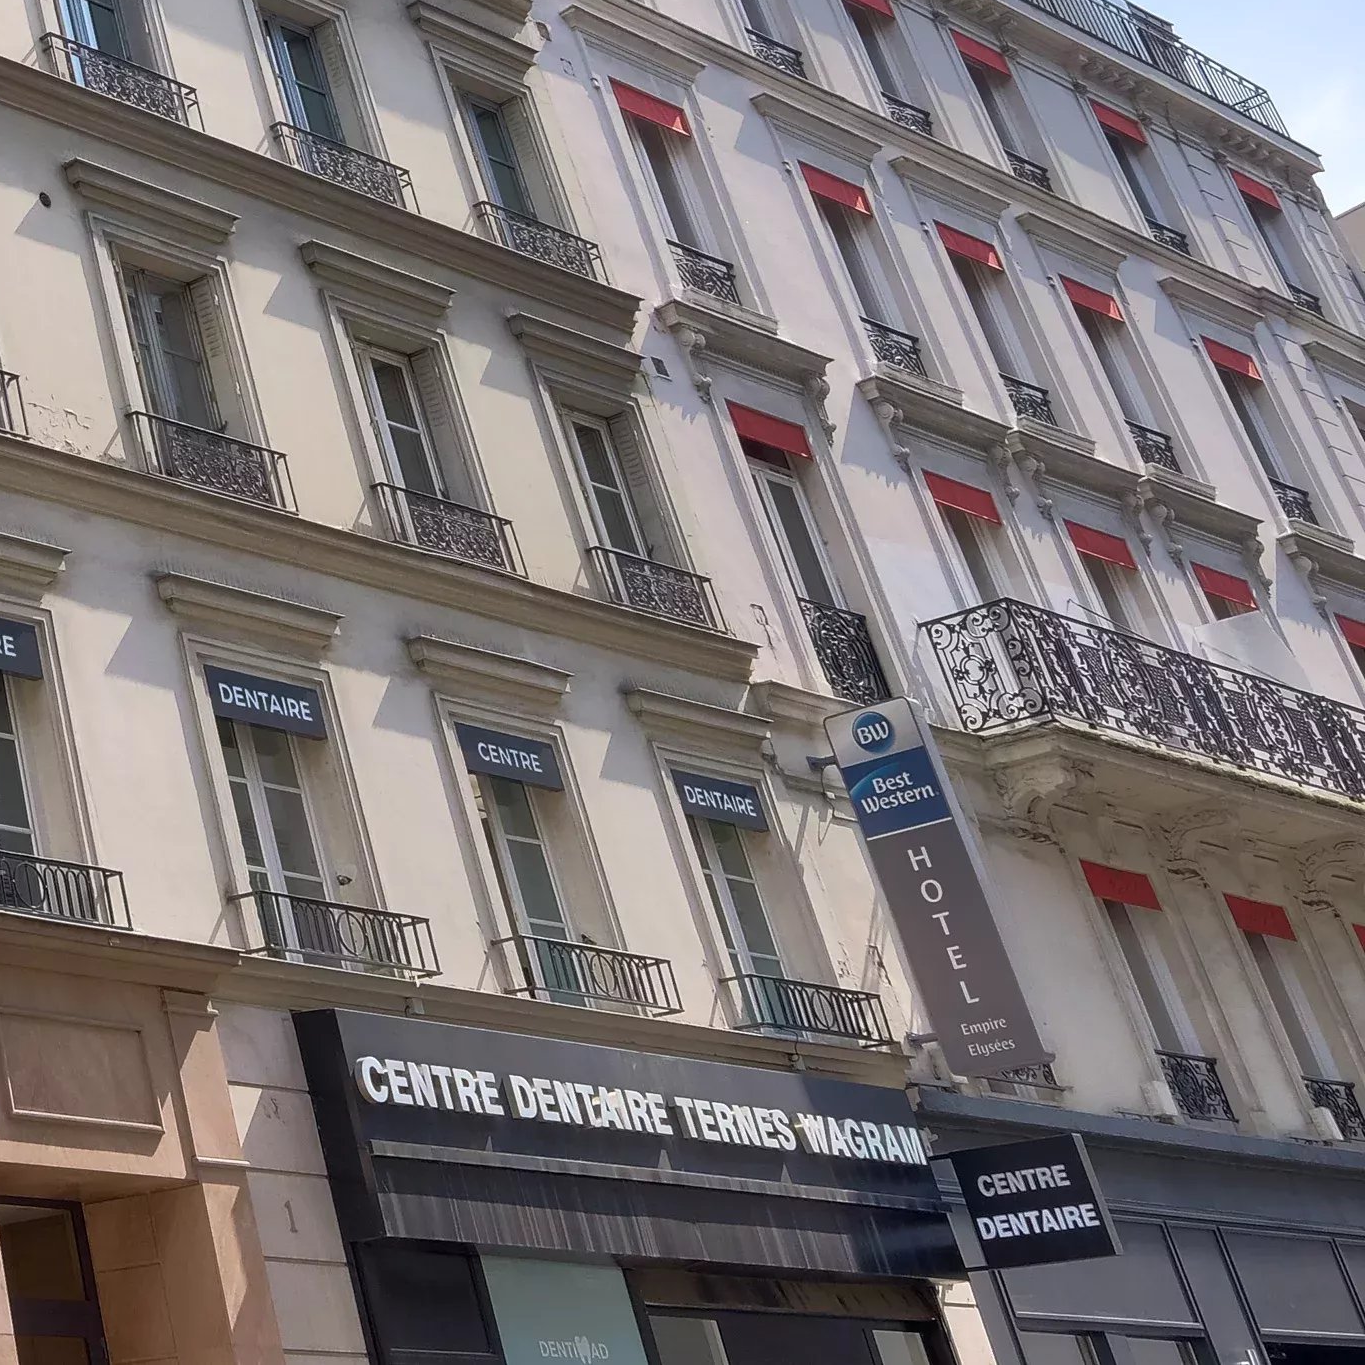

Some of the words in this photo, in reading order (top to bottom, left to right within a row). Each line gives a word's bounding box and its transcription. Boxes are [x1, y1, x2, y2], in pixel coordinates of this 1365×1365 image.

[218, 681, 313, 722] DENTAIRE
[856, 720, 890, 745] BW
[477, 741, 543, 773] CENTRE
[861, 783, 935, 814] Western
[872, 771, 914, 794] Best
[683, 784, 758, 817] DENTAIRE
[907, 846, 980, 1004] HOTEL
[960, 1017, 1008, 1036] Empire
[968, 1037, 1016, 1057] Elysées
[354, 1056, 505, 1117] CENTRE
[507, 1074, 674, 1136] DENTAIRE
[673, 1096, 797, 1152] TERNES
[796, 1112, 929, 1166] WAGRAM
[977, 1164, 1072, 1198] CENTRE
[975, 1203, 1101, 1241] DENTAIRE
